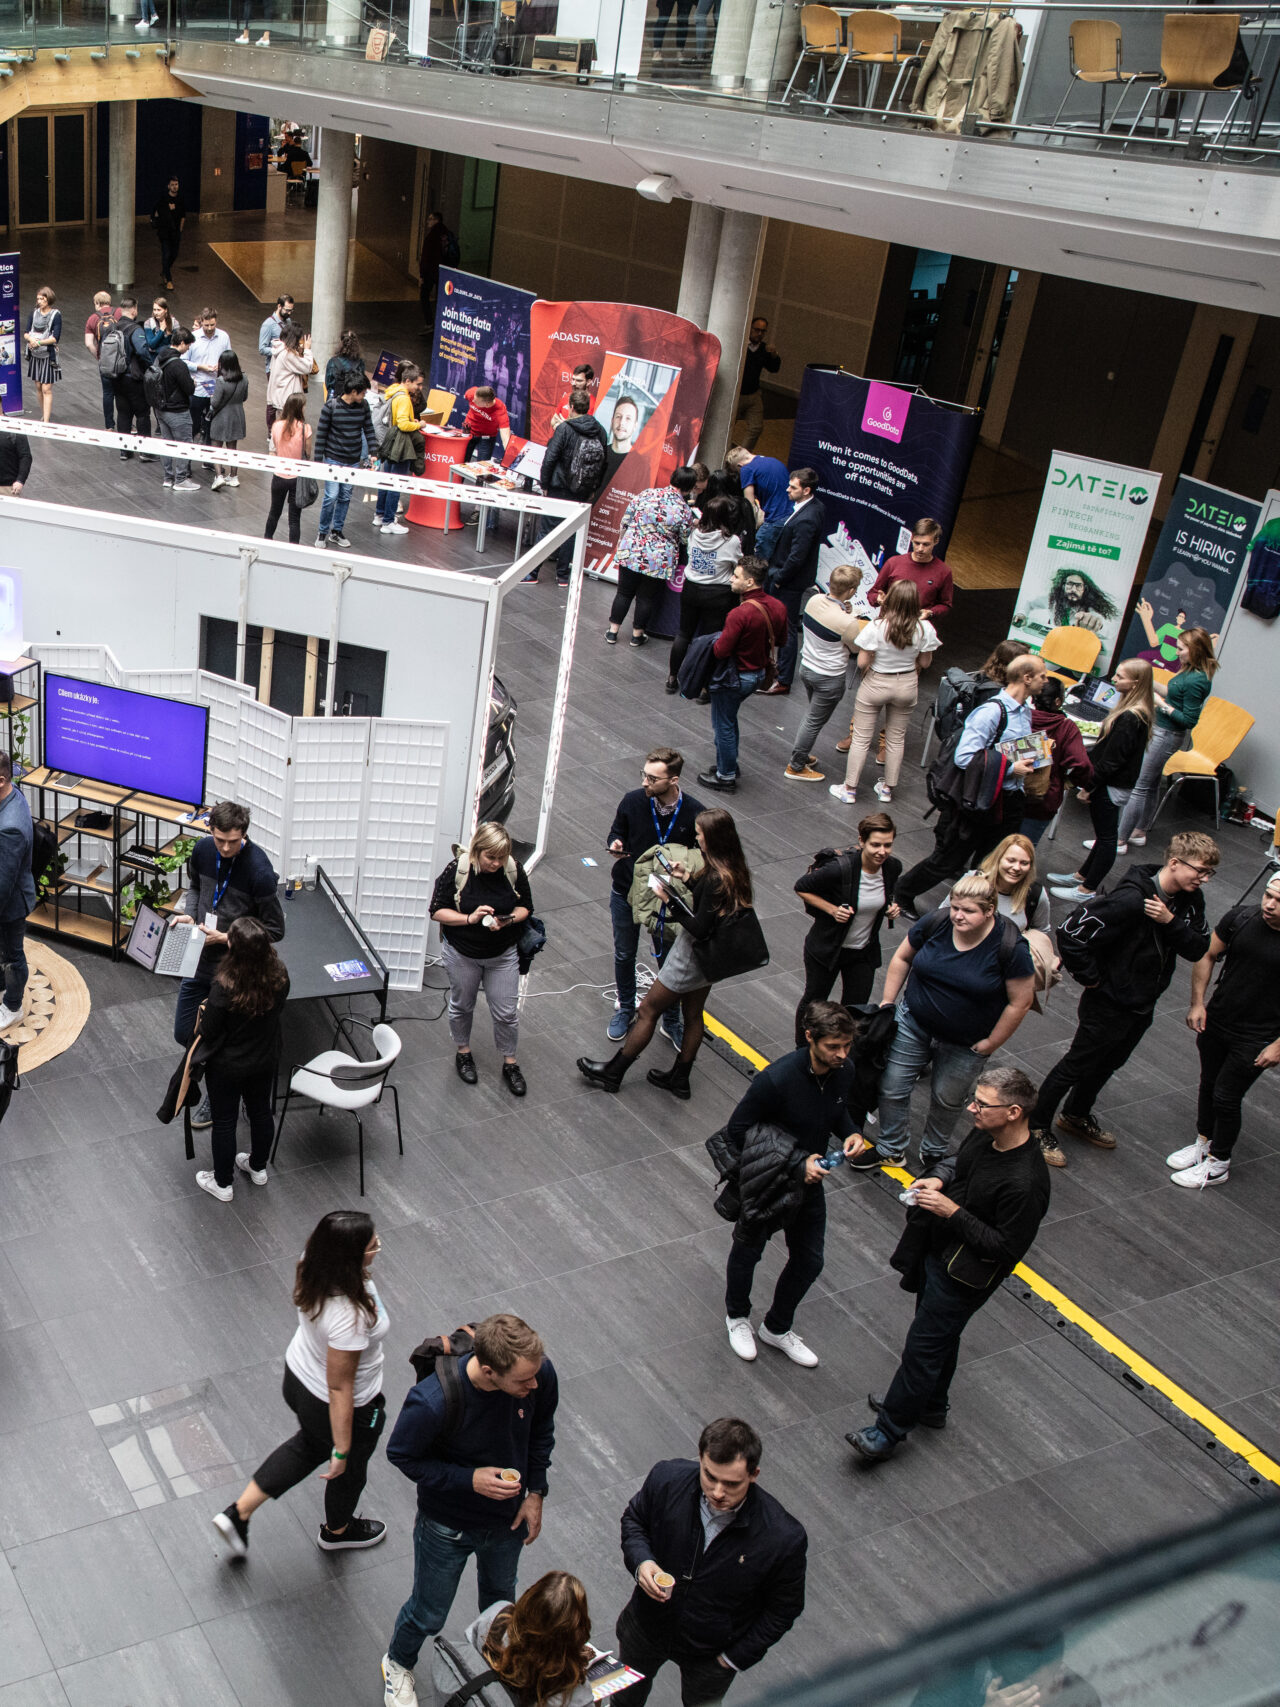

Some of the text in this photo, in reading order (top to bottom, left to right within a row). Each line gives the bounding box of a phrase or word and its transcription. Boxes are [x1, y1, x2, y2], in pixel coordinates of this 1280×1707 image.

[441, 320, 481, 341] adventure
[442, 306, 491, 332] Join the data
[552, 331, 600, 345] ADASTRA
[867, 417, 899, 435] GoodData
[818, 440, 919, 485] When it comes to GoodData,
[832, 455, 906, 490] the opportunities are
[844, 472, 893, 497] off the charts.
[1051, 506, 1094, 522] FINTECH
[1056, 539, 1112, 556] Zajímá tě to?
[1175, 529, 1188, 545] IS
[1189, 535, 1237, 564] HIRING
